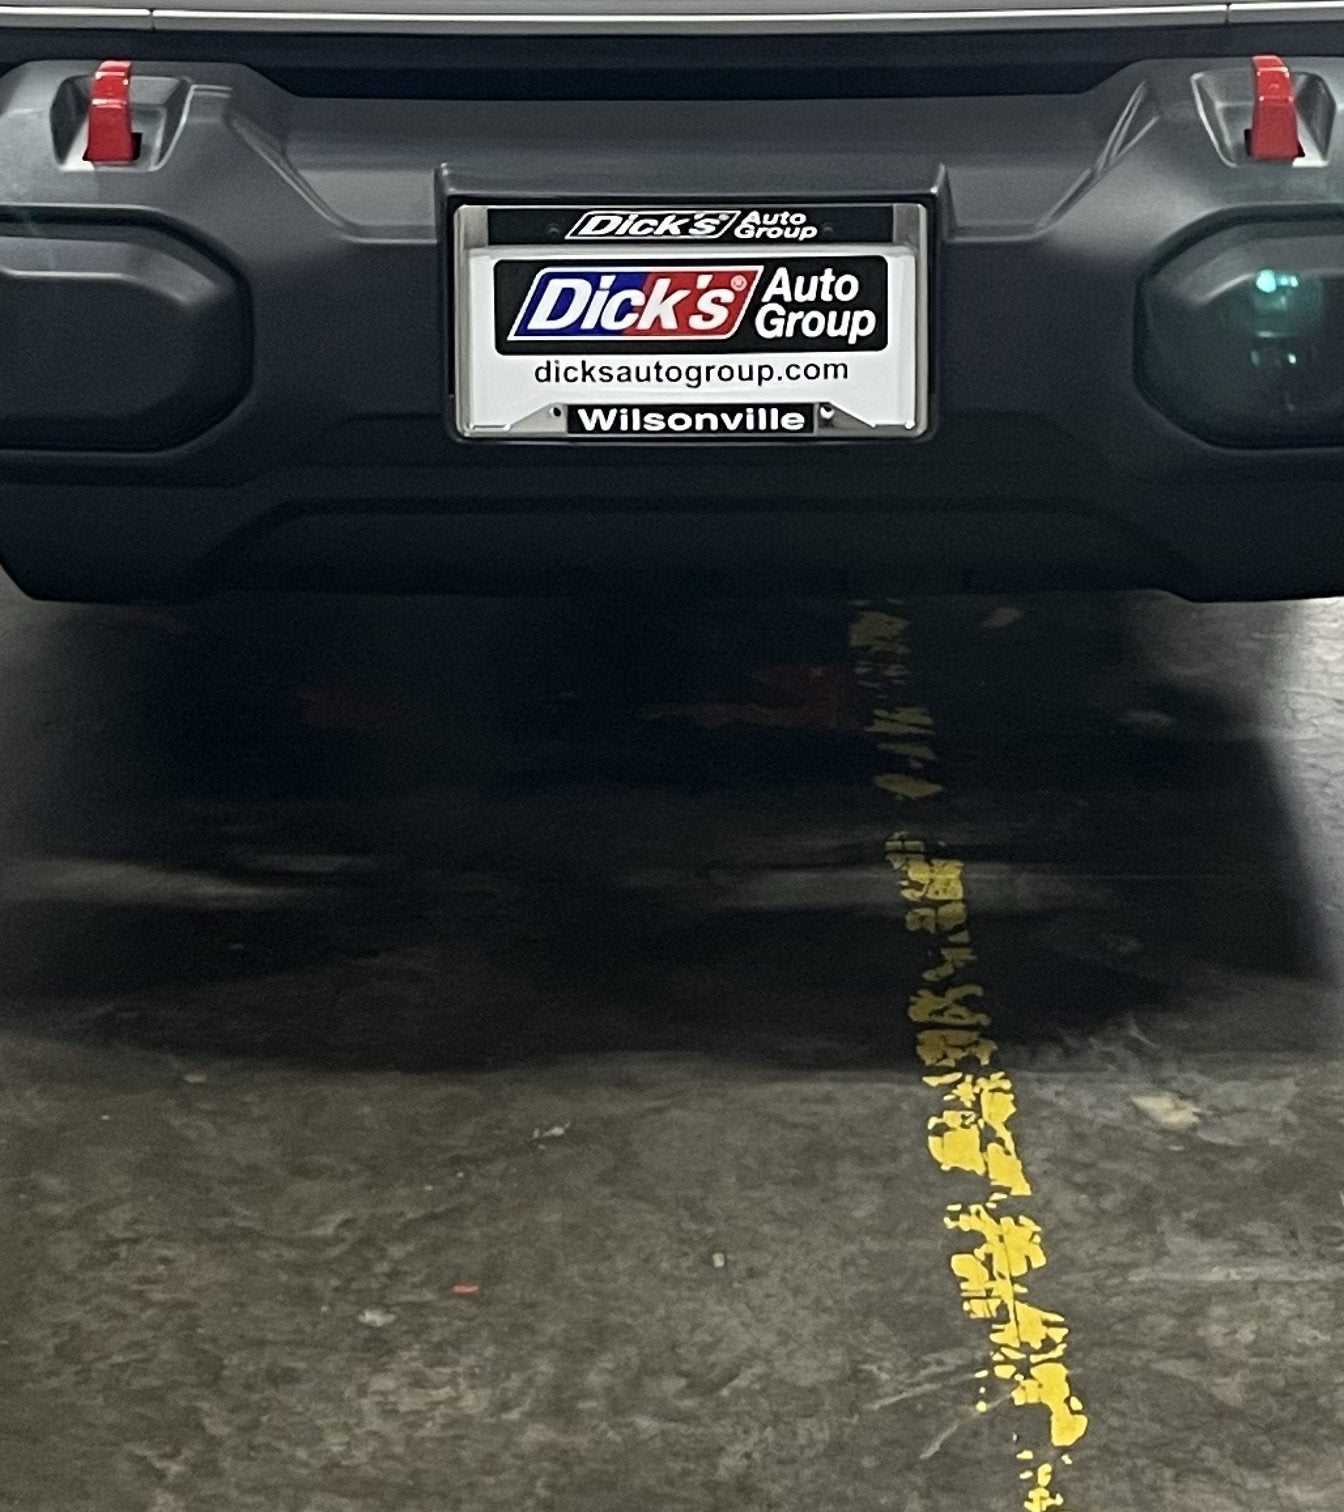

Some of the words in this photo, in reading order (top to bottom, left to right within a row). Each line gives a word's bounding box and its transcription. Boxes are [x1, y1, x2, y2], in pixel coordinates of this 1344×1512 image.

[577, 212, 722, 236] Dick's
[741, 210, 807, 226] Auto
[734, 225, 818, 241] Group
[760, 266, 859, 303] Auto
[526, 274, 736, 331] Dick's
[755, 302, 877, 345] Group
[534, 359, 849, 388] dicksautogroup.com
[577, 407, 806, 432] Wilsonville
